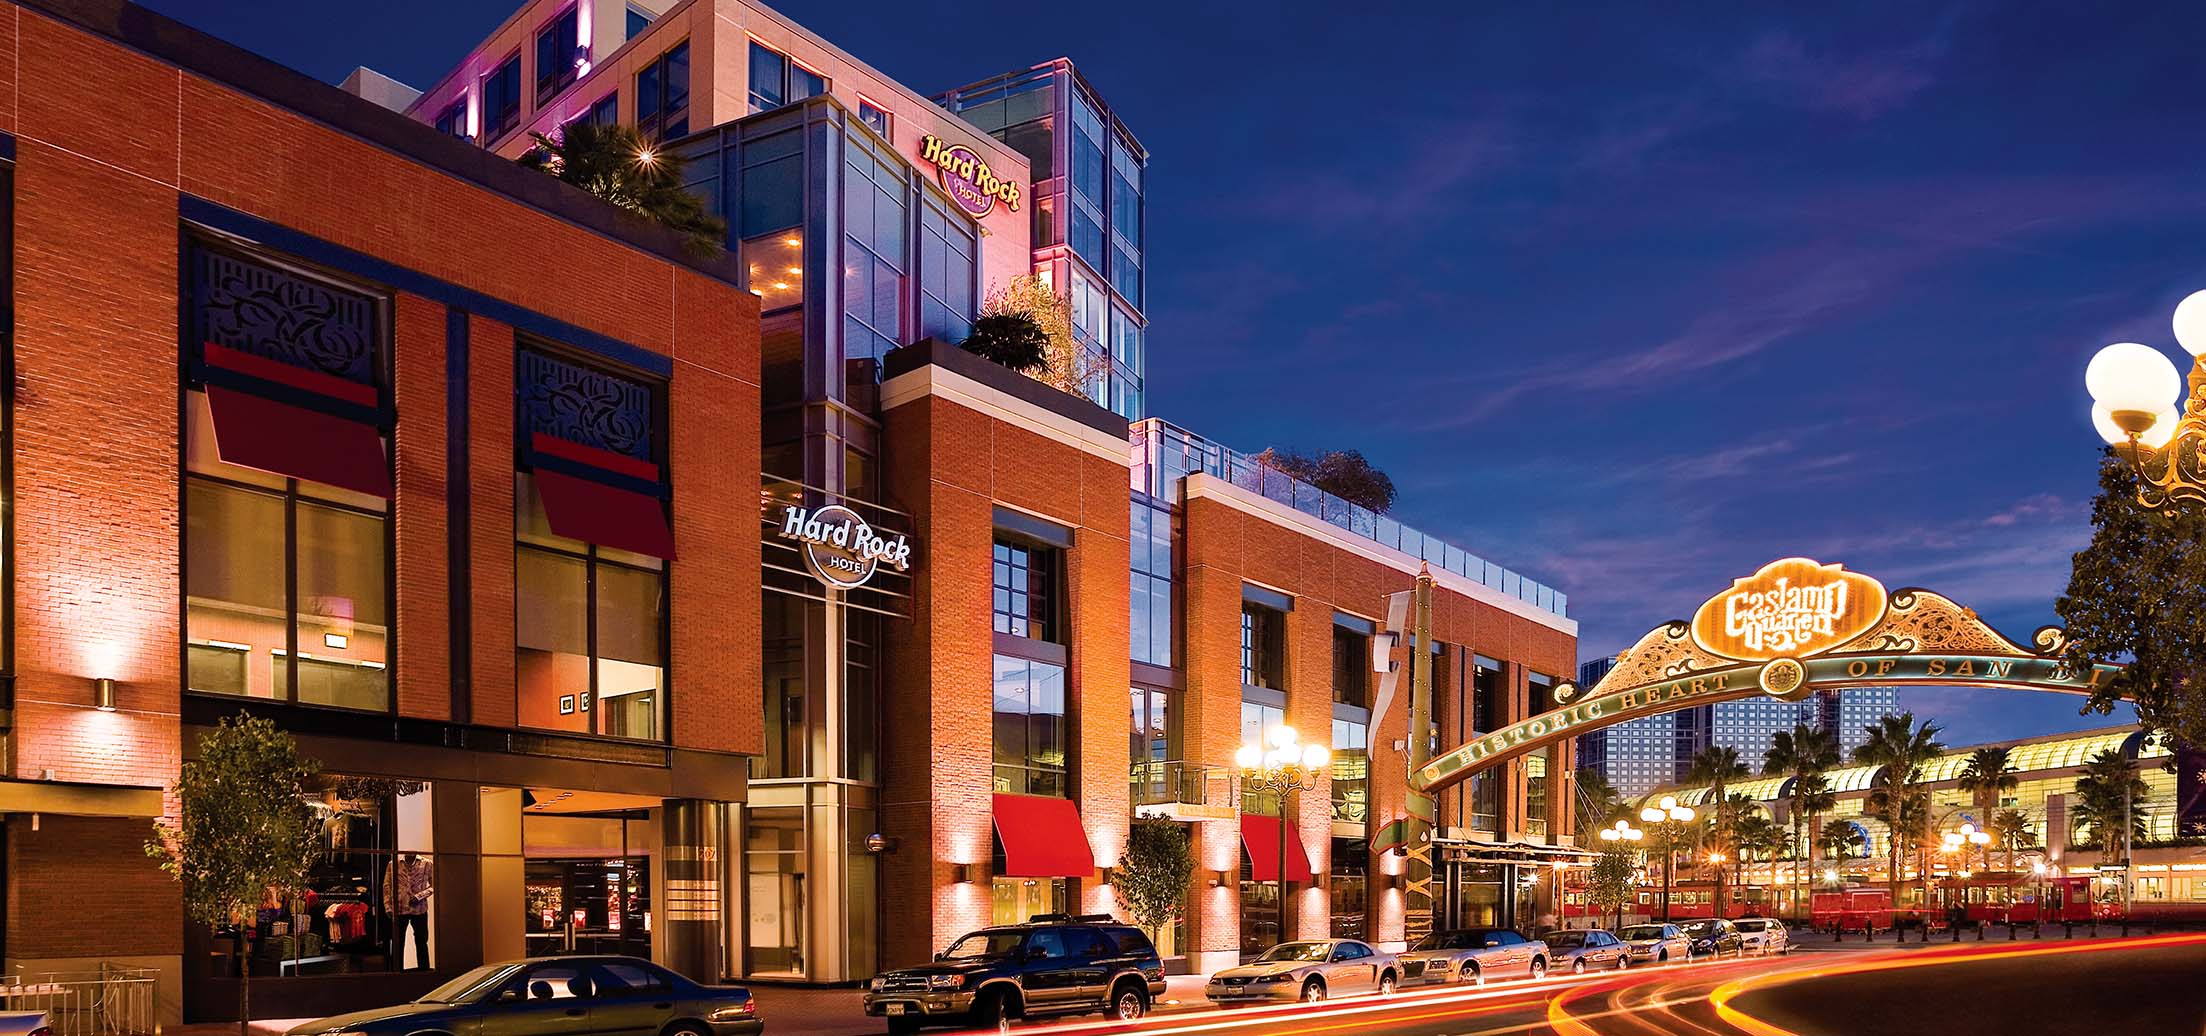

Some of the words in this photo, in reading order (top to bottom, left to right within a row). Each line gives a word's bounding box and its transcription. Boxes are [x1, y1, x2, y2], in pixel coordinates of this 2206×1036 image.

[922, 134, 974, 180] Hard
[975, 163, 1021, 211] Rock
[957, 186, 987, 208] HOTEL
[784, 505, 851, 547] Hard
[853, 522, 911, 569] Rock
[830, 555, 867, 575] HOTEL
[1725, 577, 1848, 637] Gaslamp
[1456, 701, 1603, 766] HISTORIC
[1620, 674, 1731, 710] HEART
[1847, 659, 1896, 678] OF
[1926, 659, 2014, 679] SAN
